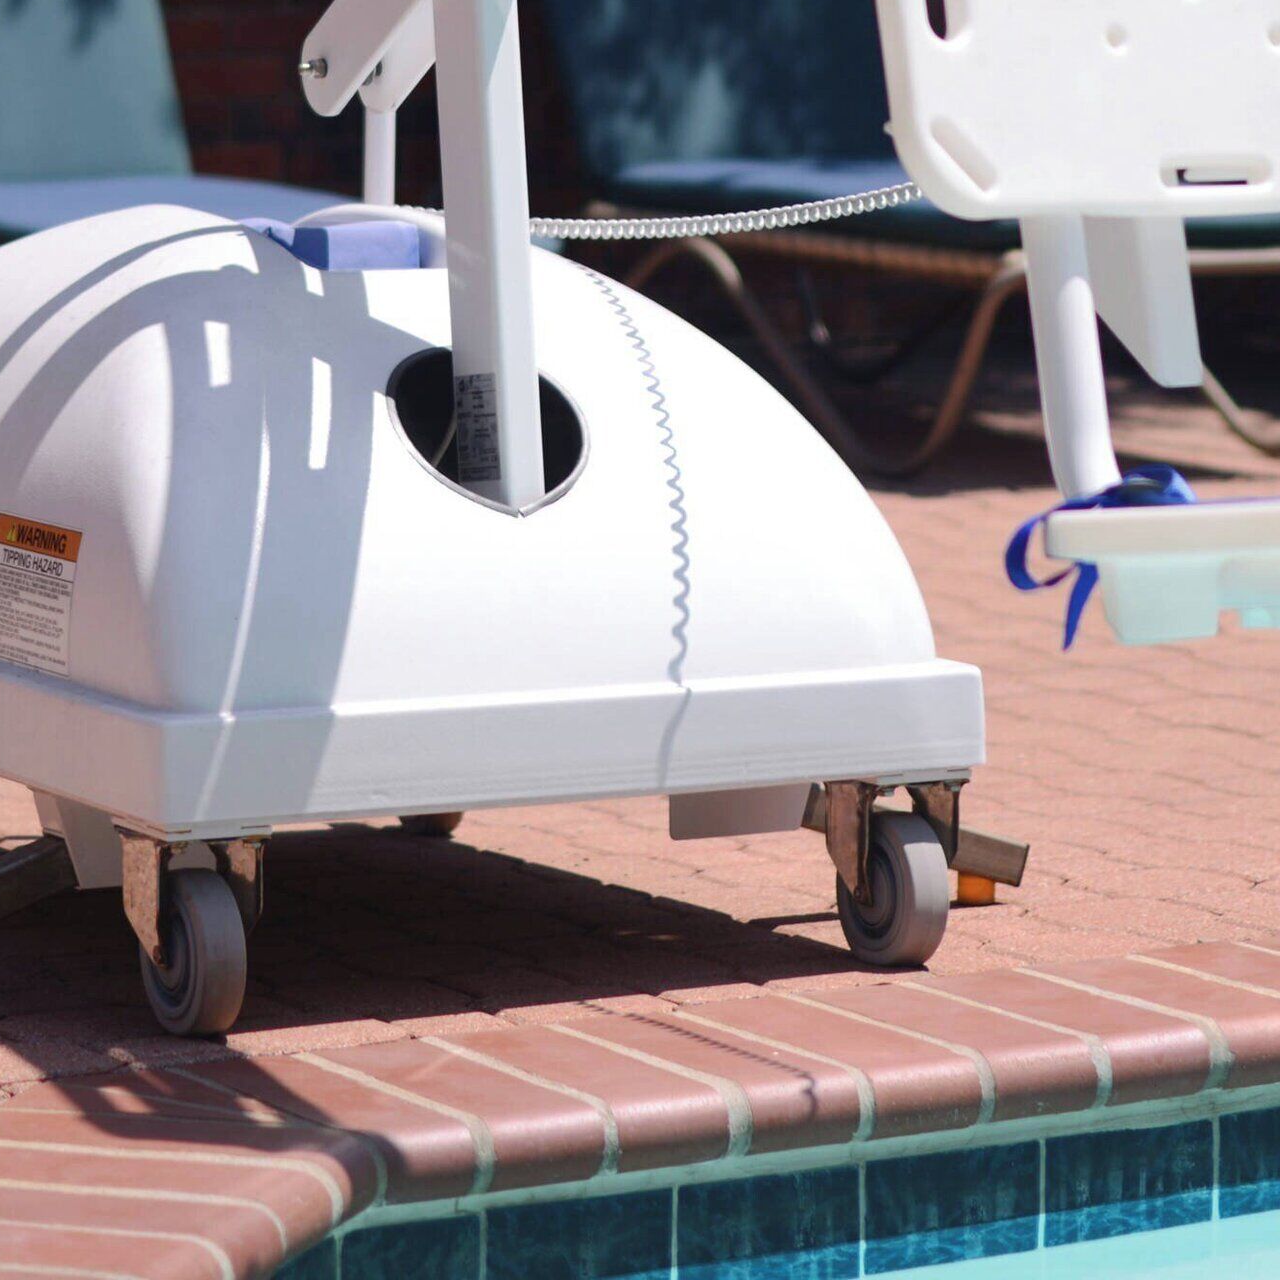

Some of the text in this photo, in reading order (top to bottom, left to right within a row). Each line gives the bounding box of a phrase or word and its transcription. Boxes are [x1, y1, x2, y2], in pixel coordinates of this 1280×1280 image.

[16, 521, 68, 555] WARNING
[2, 548, 64, 578] TIPPING HAZARD
